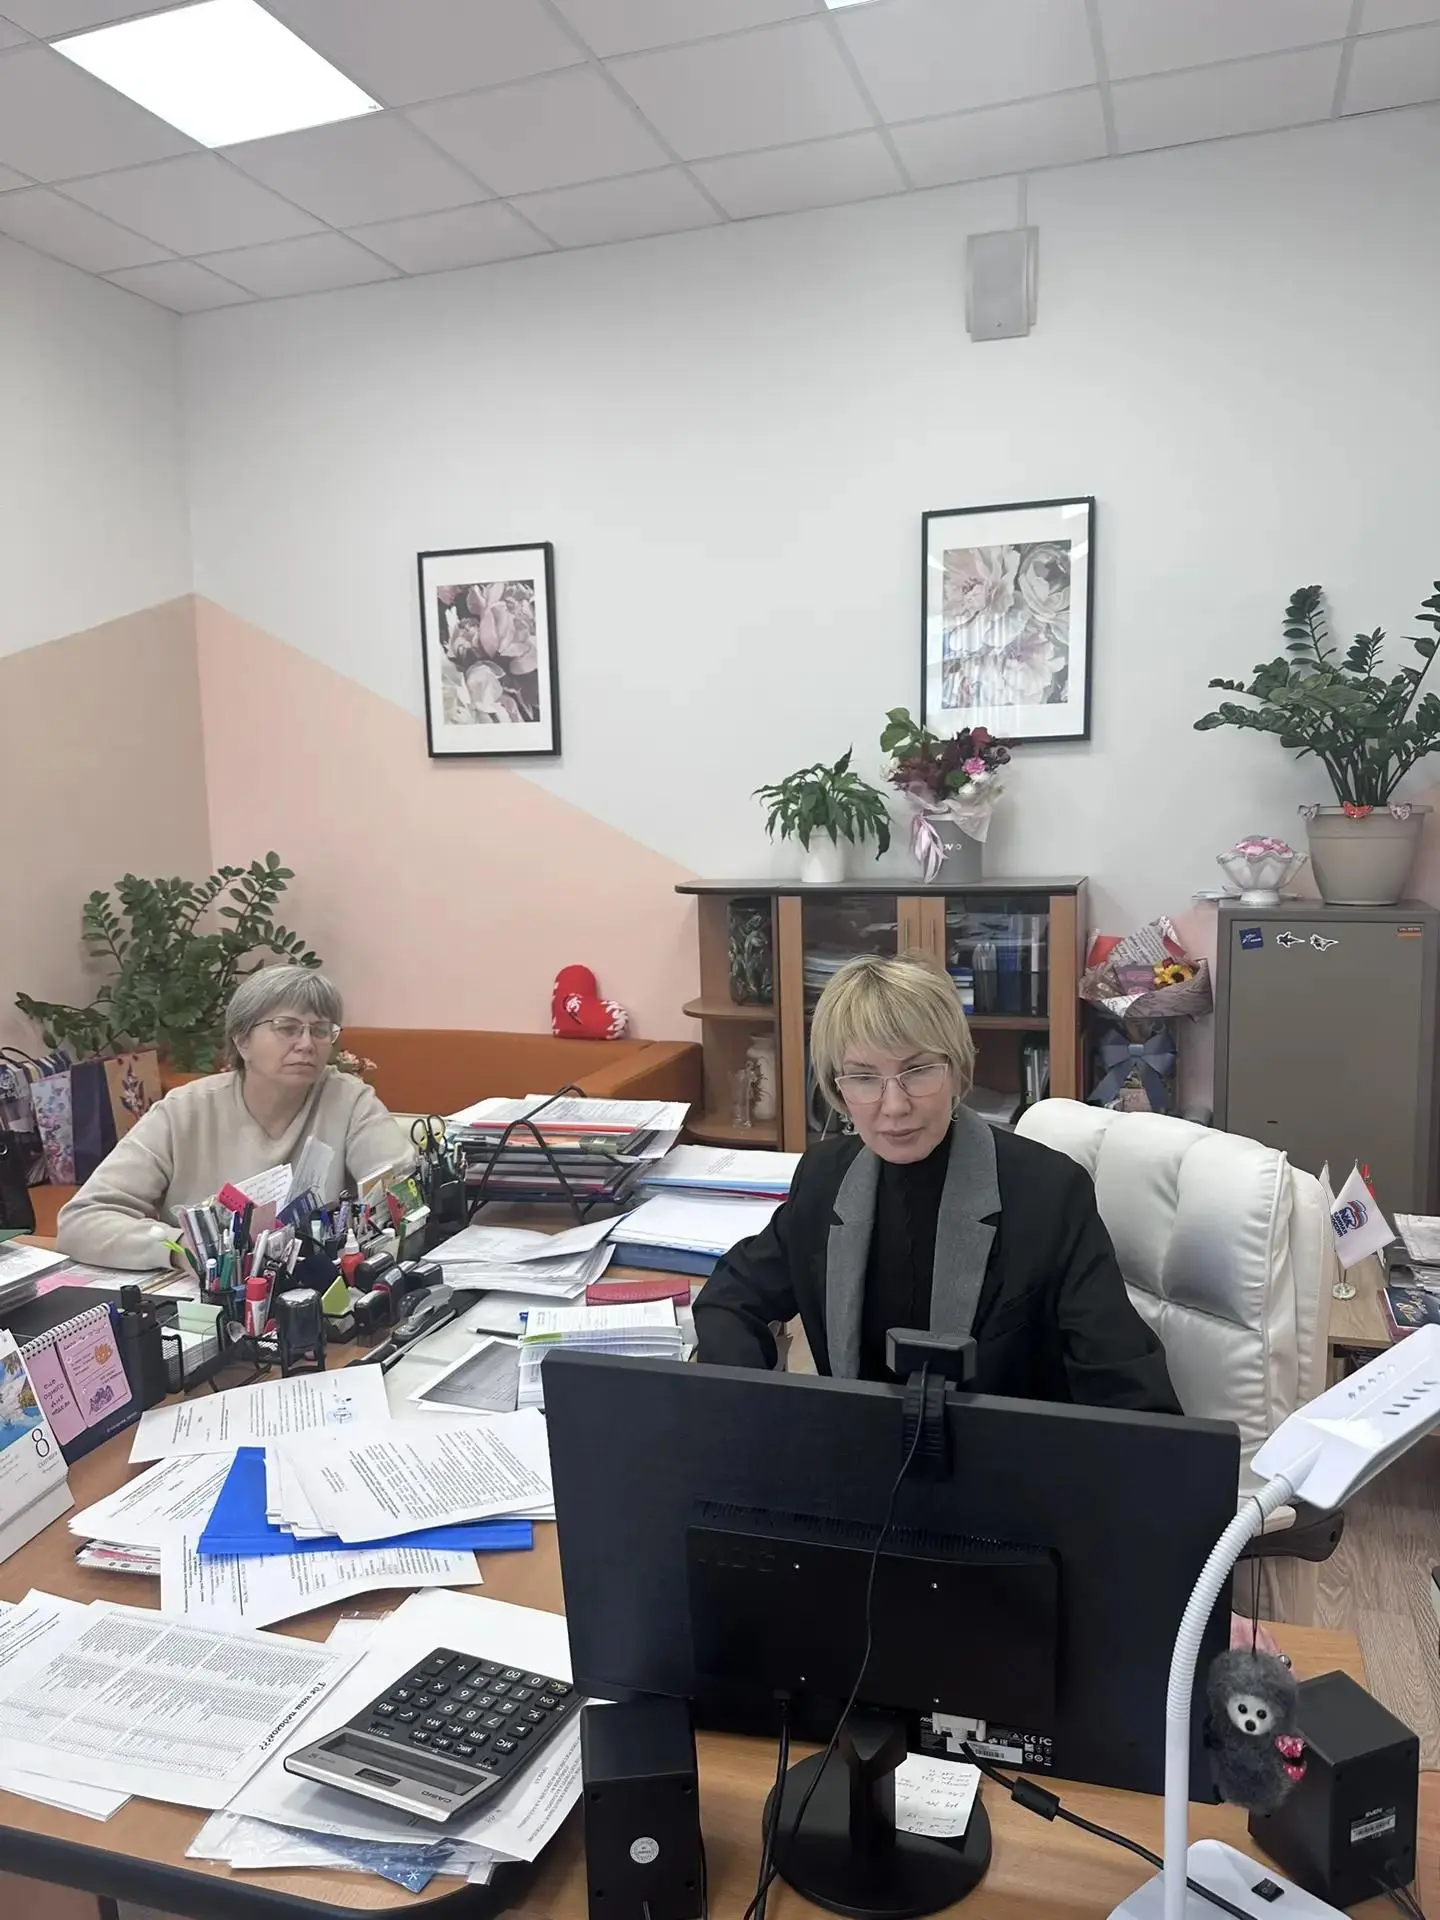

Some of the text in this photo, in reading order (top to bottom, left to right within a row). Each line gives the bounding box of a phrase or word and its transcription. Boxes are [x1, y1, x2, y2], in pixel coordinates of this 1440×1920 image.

[31, 1428, 50, 1458] 8
[531, 1676, 541, 1685] 0
[473, 1677, 525, 1697] 1 2 3
[479, 1696, 491, 1705] 5
[539, 1696, 556, 1705] ON
[378, 1703, 394, 1712] MU
[444, 1704, 498, 1725] 7 8 9
[469, 1731, 486, 1740] MR
[496, 1738, 514, 1748] MC
[421, 1790, 453, 1804] CASIO
[1364, 1807, 1383, 1817] SVEN
